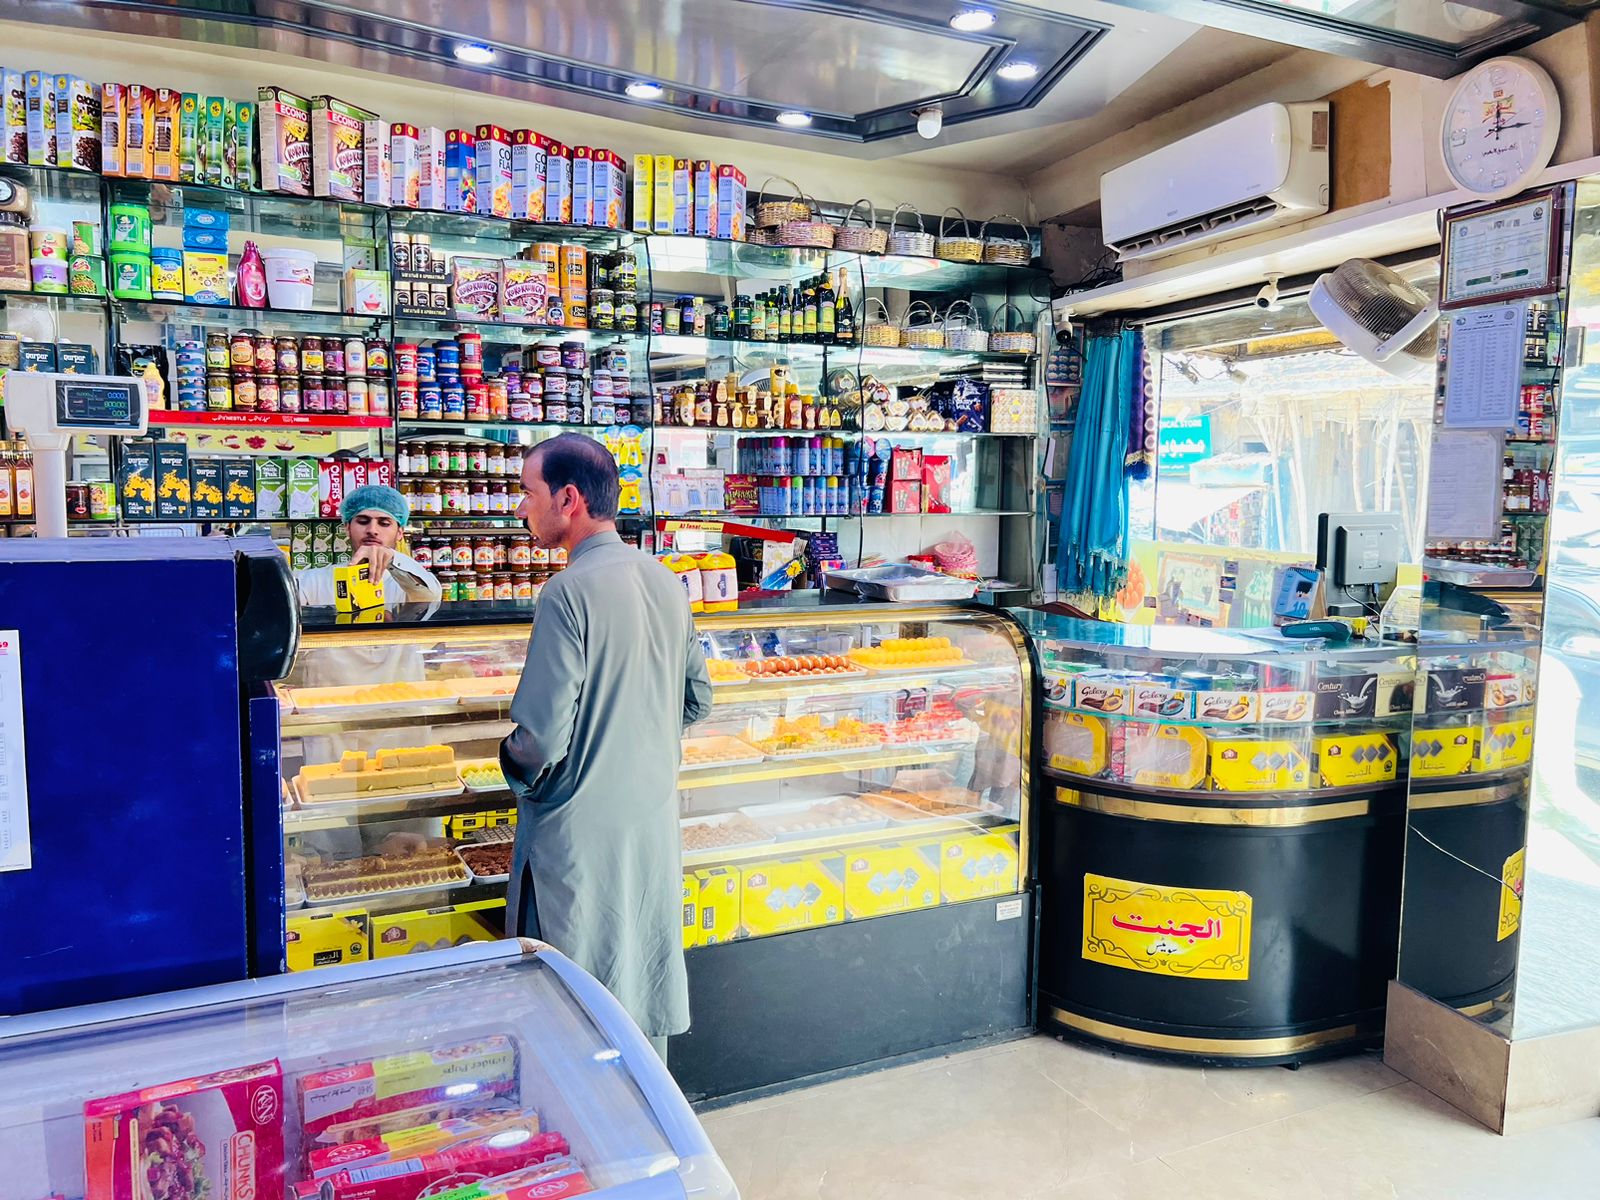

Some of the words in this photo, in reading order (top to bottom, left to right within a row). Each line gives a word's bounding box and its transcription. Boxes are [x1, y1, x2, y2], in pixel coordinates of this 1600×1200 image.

[280, 104, 307, 122] ECONO
[332, 113, 359, 129] ECONO
[498, 147, 511, 159] CO
[535, 152, 546, 164] CO
[498, 159, 512, 170] FLA
[535, 163, 547, 173] FLA
[1317, 681, 1344, 691] Century
[1081, 686, 1108, 700] Galaxy
[1138, 689, 1168, 702] Galaxy
[1203, 695, 1233, 708] Galaxy
[1112, 913, 1223, 945] الجنت
[235, 1133, 254, 1199] CHUNKS
